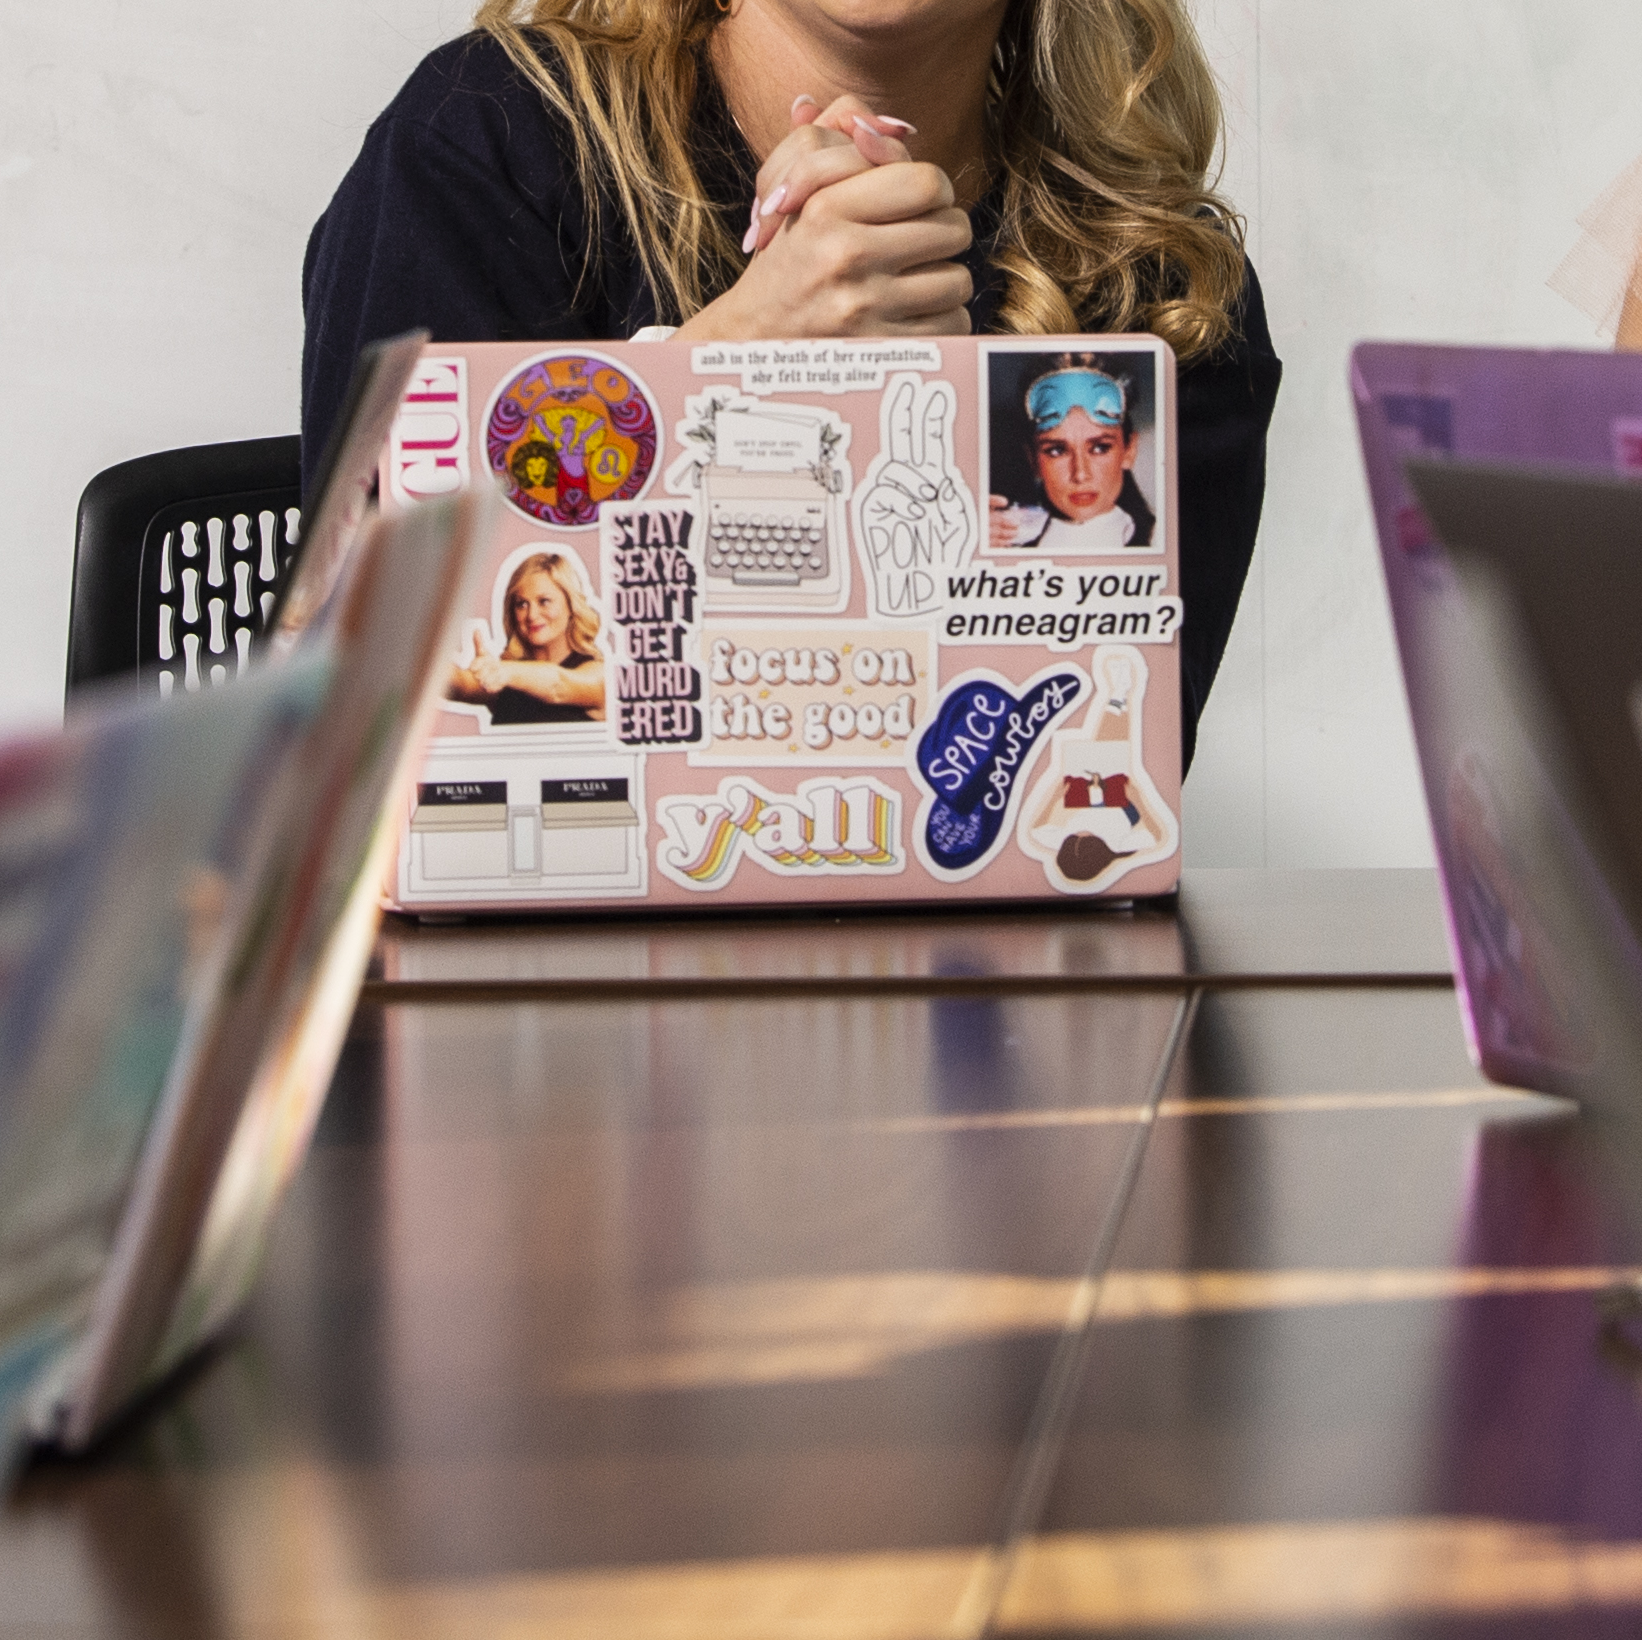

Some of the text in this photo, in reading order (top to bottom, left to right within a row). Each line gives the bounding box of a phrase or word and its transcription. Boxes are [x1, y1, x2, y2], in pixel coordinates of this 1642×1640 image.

[701, 352, 726, 366] and
[730, 352, 743, 366] in
[748, 351, 768, 365] the
[773, 349, 809, 364] death
[813, 348, 828, 364] of
[833, 348, 854, 363] her
[751, 368, 877, 385] she felt truly alive
[400, 364, 461, 496] GUE
[611, 510, 693, 549] STAY
[868, 521, 960, 571] PONY
[612, 584, 695, 623] DON'T
[887, 570, 935, 611] UP
[947, 569, 1161, 605] what's your
[625, 622, 686, 662] GET
[945, 605, 1176, 644] enneagram?
[614, 661, 700, 702] MURD
[710, 637, 917, 687] focus on
[615, 700, 701, 744] ERED
[710, 692, 916, 750] the good
[664, 783, 898, 882] y'all
